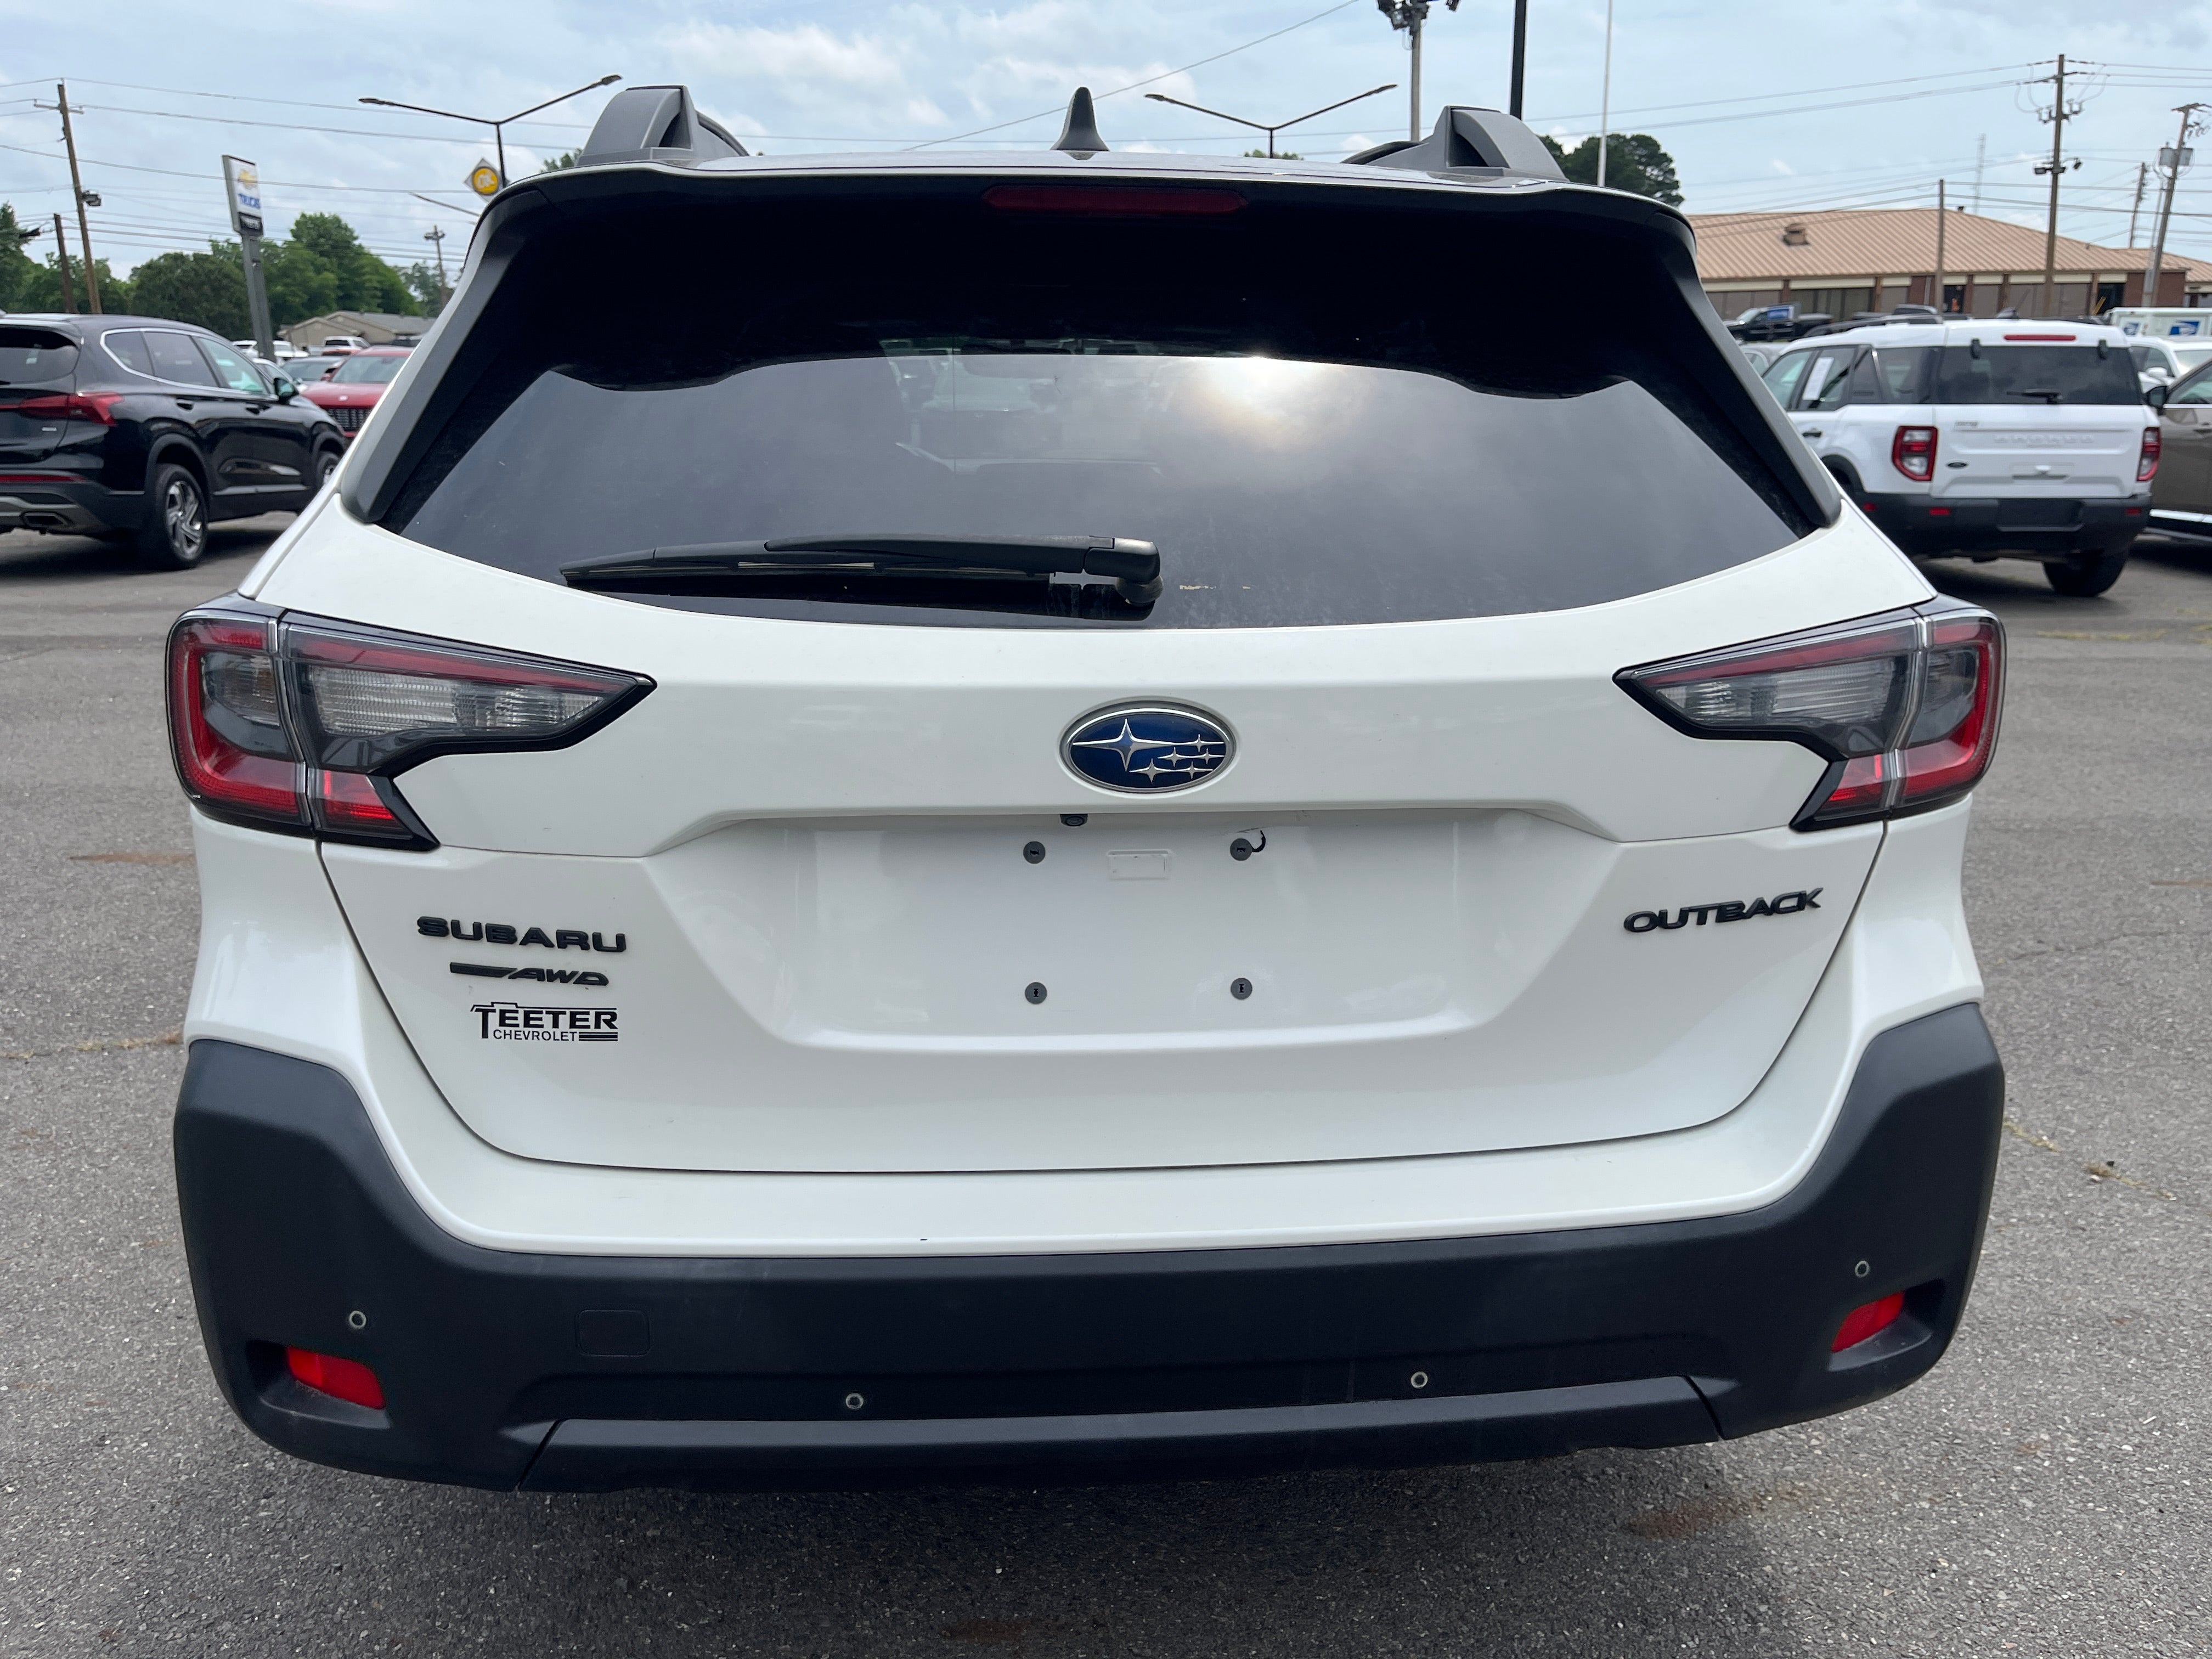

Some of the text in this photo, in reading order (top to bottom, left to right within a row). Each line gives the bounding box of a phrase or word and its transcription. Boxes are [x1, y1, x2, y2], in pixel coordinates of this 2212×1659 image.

[1623, 887, 1824, 933] OUTBACK
[416, 916, 627, 953] SUBARU
[507, 967, 610, 987] AWD
[474, 1007, 618, 1039] TEETER
[493, 1029, 578, 1041] CHEVROLET
